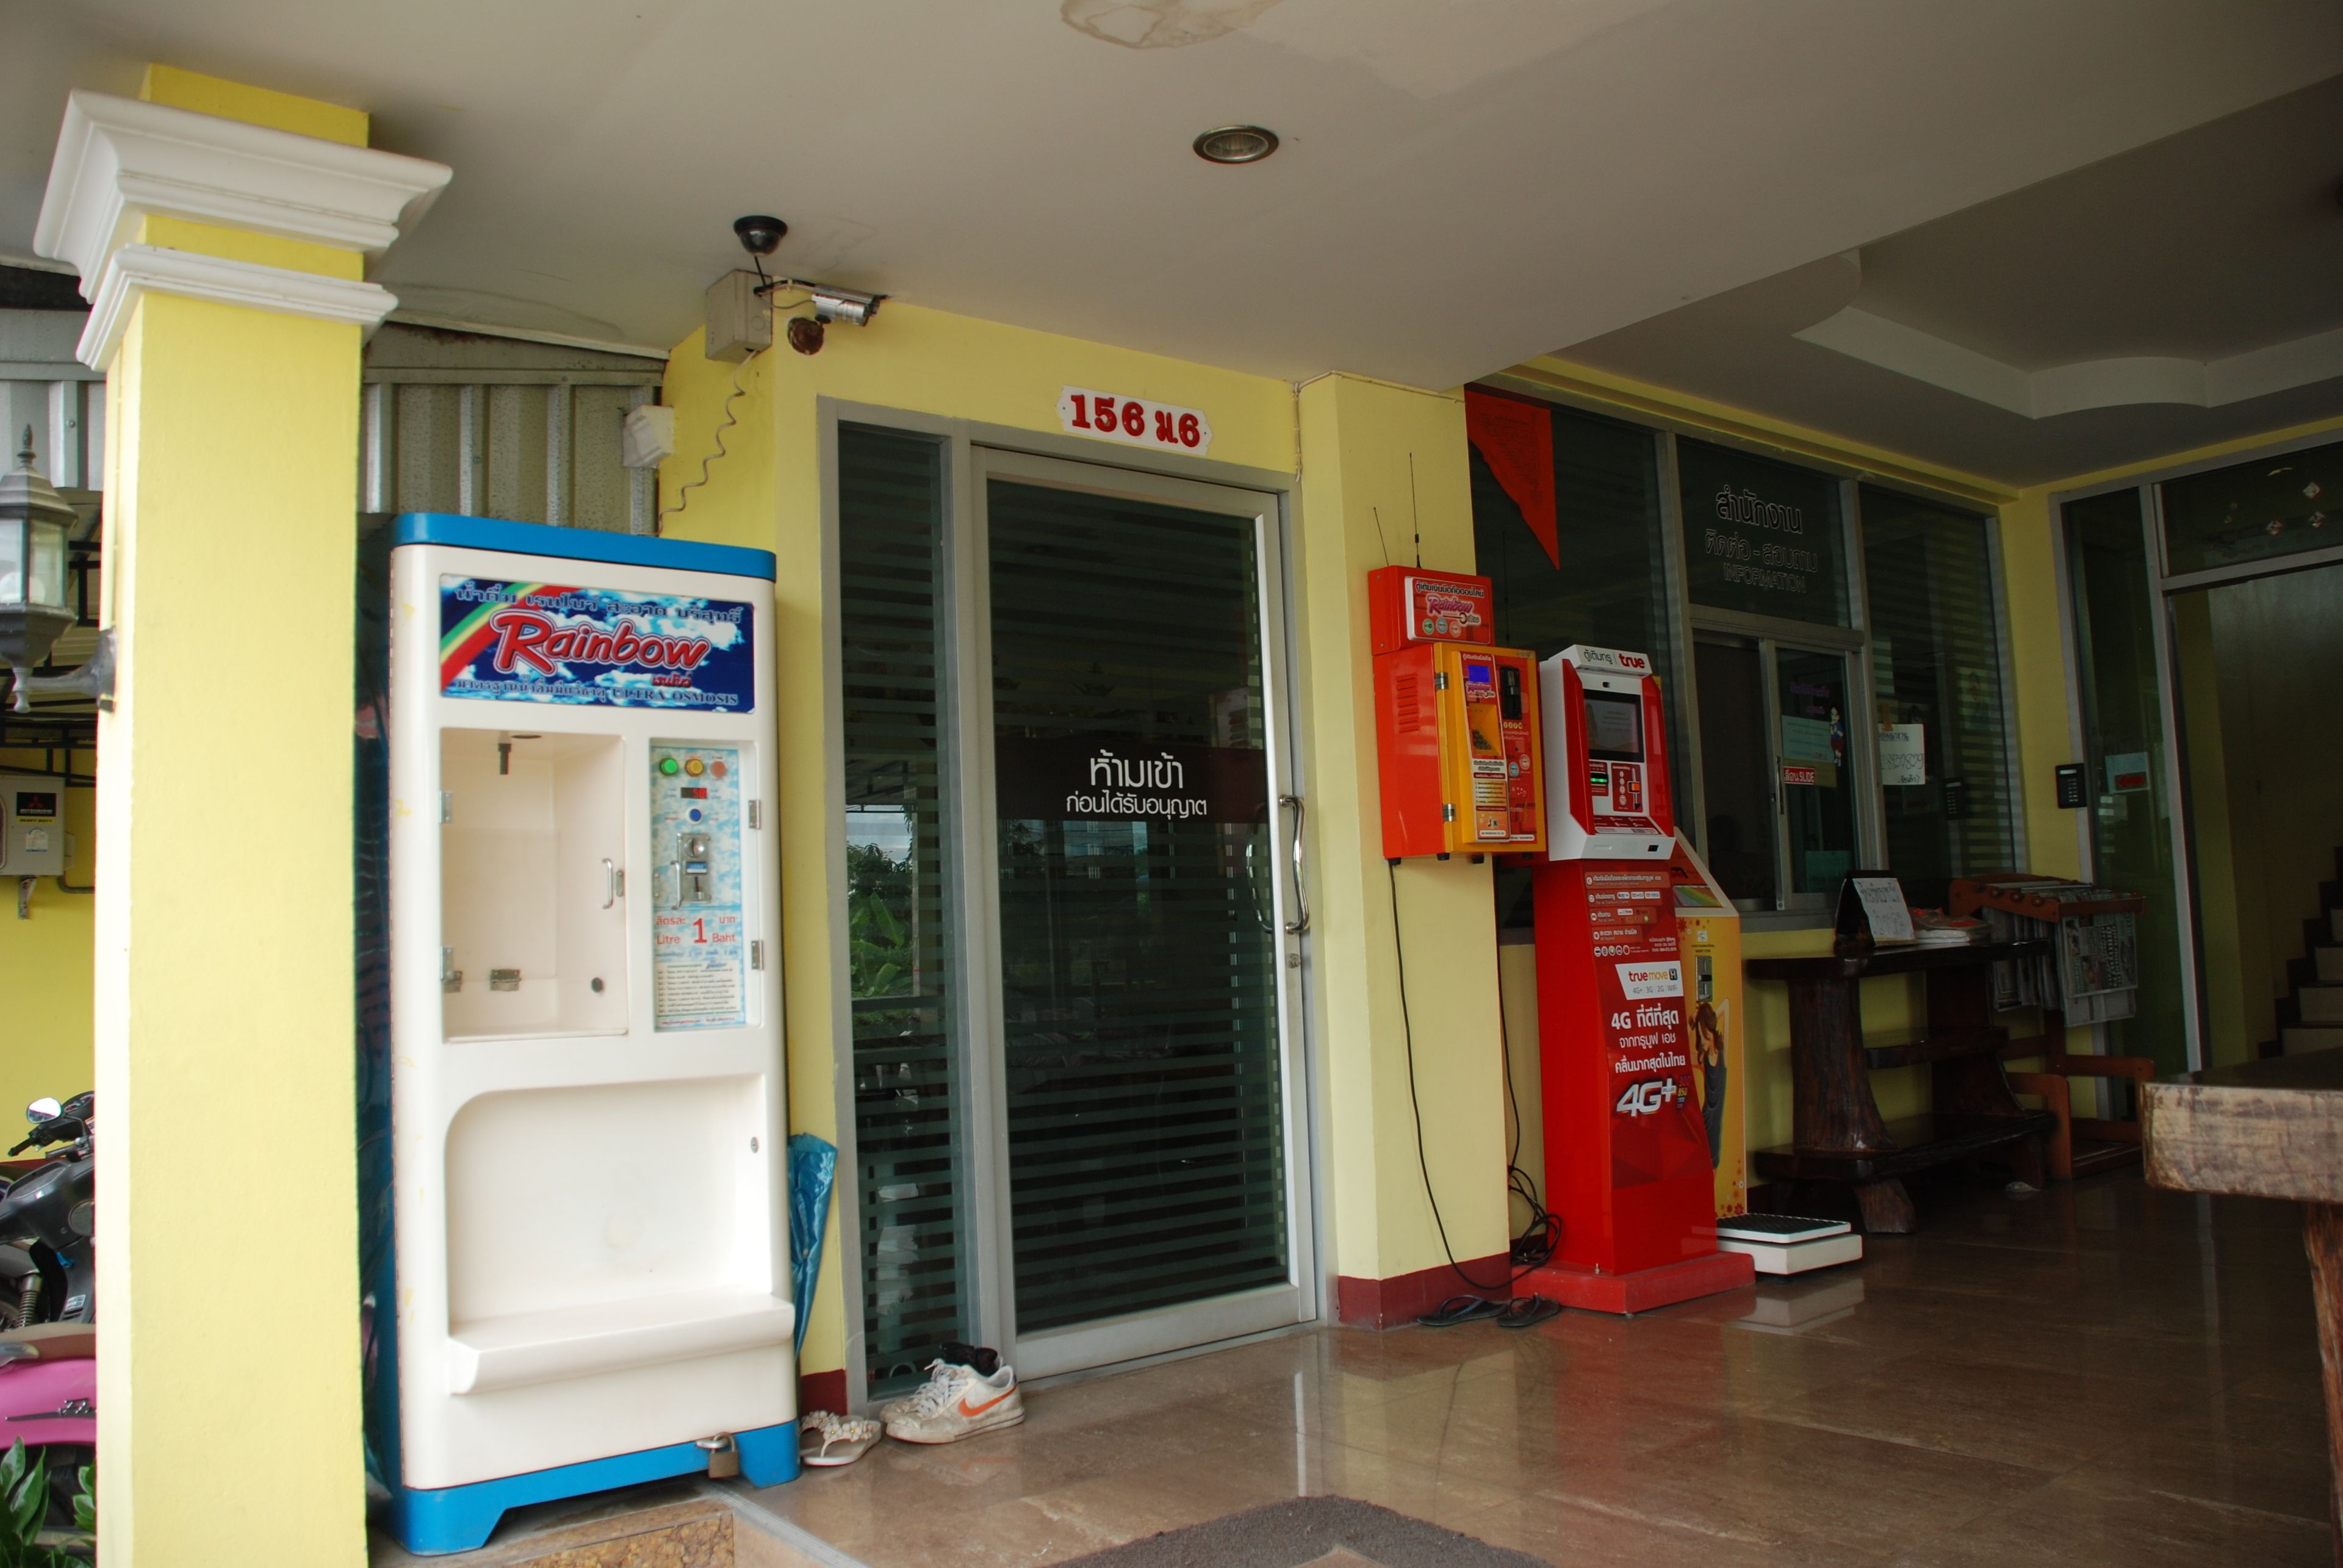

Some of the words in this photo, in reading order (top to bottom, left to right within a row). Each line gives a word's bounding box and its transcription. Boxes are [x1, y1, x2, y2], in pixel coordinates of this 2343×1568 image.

[1071, 394, 1145, 437] 156
[1716, 484, 1802, 534] สำนักงาน
[1705, 528, 1751, 560] ติดต่อ
[1763, 543, 1818, 573] สอบถาม
[1724, 563, 1806, 594] INFORMATION
[455, 581, 517, 605] น้ำดื่ม
[606, 602, 668, 617] สะอาด
[1427, 594, 1474, 616] Rainbow
[491, 610, 710, 674] Rainbow
[1618, 653, 1645, 669] true
[611, 688, 668, 701] ULTRA
[672, 690, 738, 706] OSMOSIS
[1090, 749, 1183, 789] ห้ามเข้า
[1799, 772, 1815, 783] SLIDE
[1066, 789, 1207, 820] ก่อนได้รับอนุญาต
[656, 935, 680, 945] Litre
[712, 933, 736, 943] Baht
[692, 917, 708, 943] 1
[1611, 1012, 1632, 1030] 4G
[1636, 1002, 1679, 1030] ที่ดีที่สุด
[1619, 1032, 1658, 1049] จากทรูมูฟ
[1661, 1033, 1677, 1044] เอช
[1614, 1051, 1686, 1074] คลื่นมากสุดในไทย
[1616, 1077, 1677, 1117] 4G+
